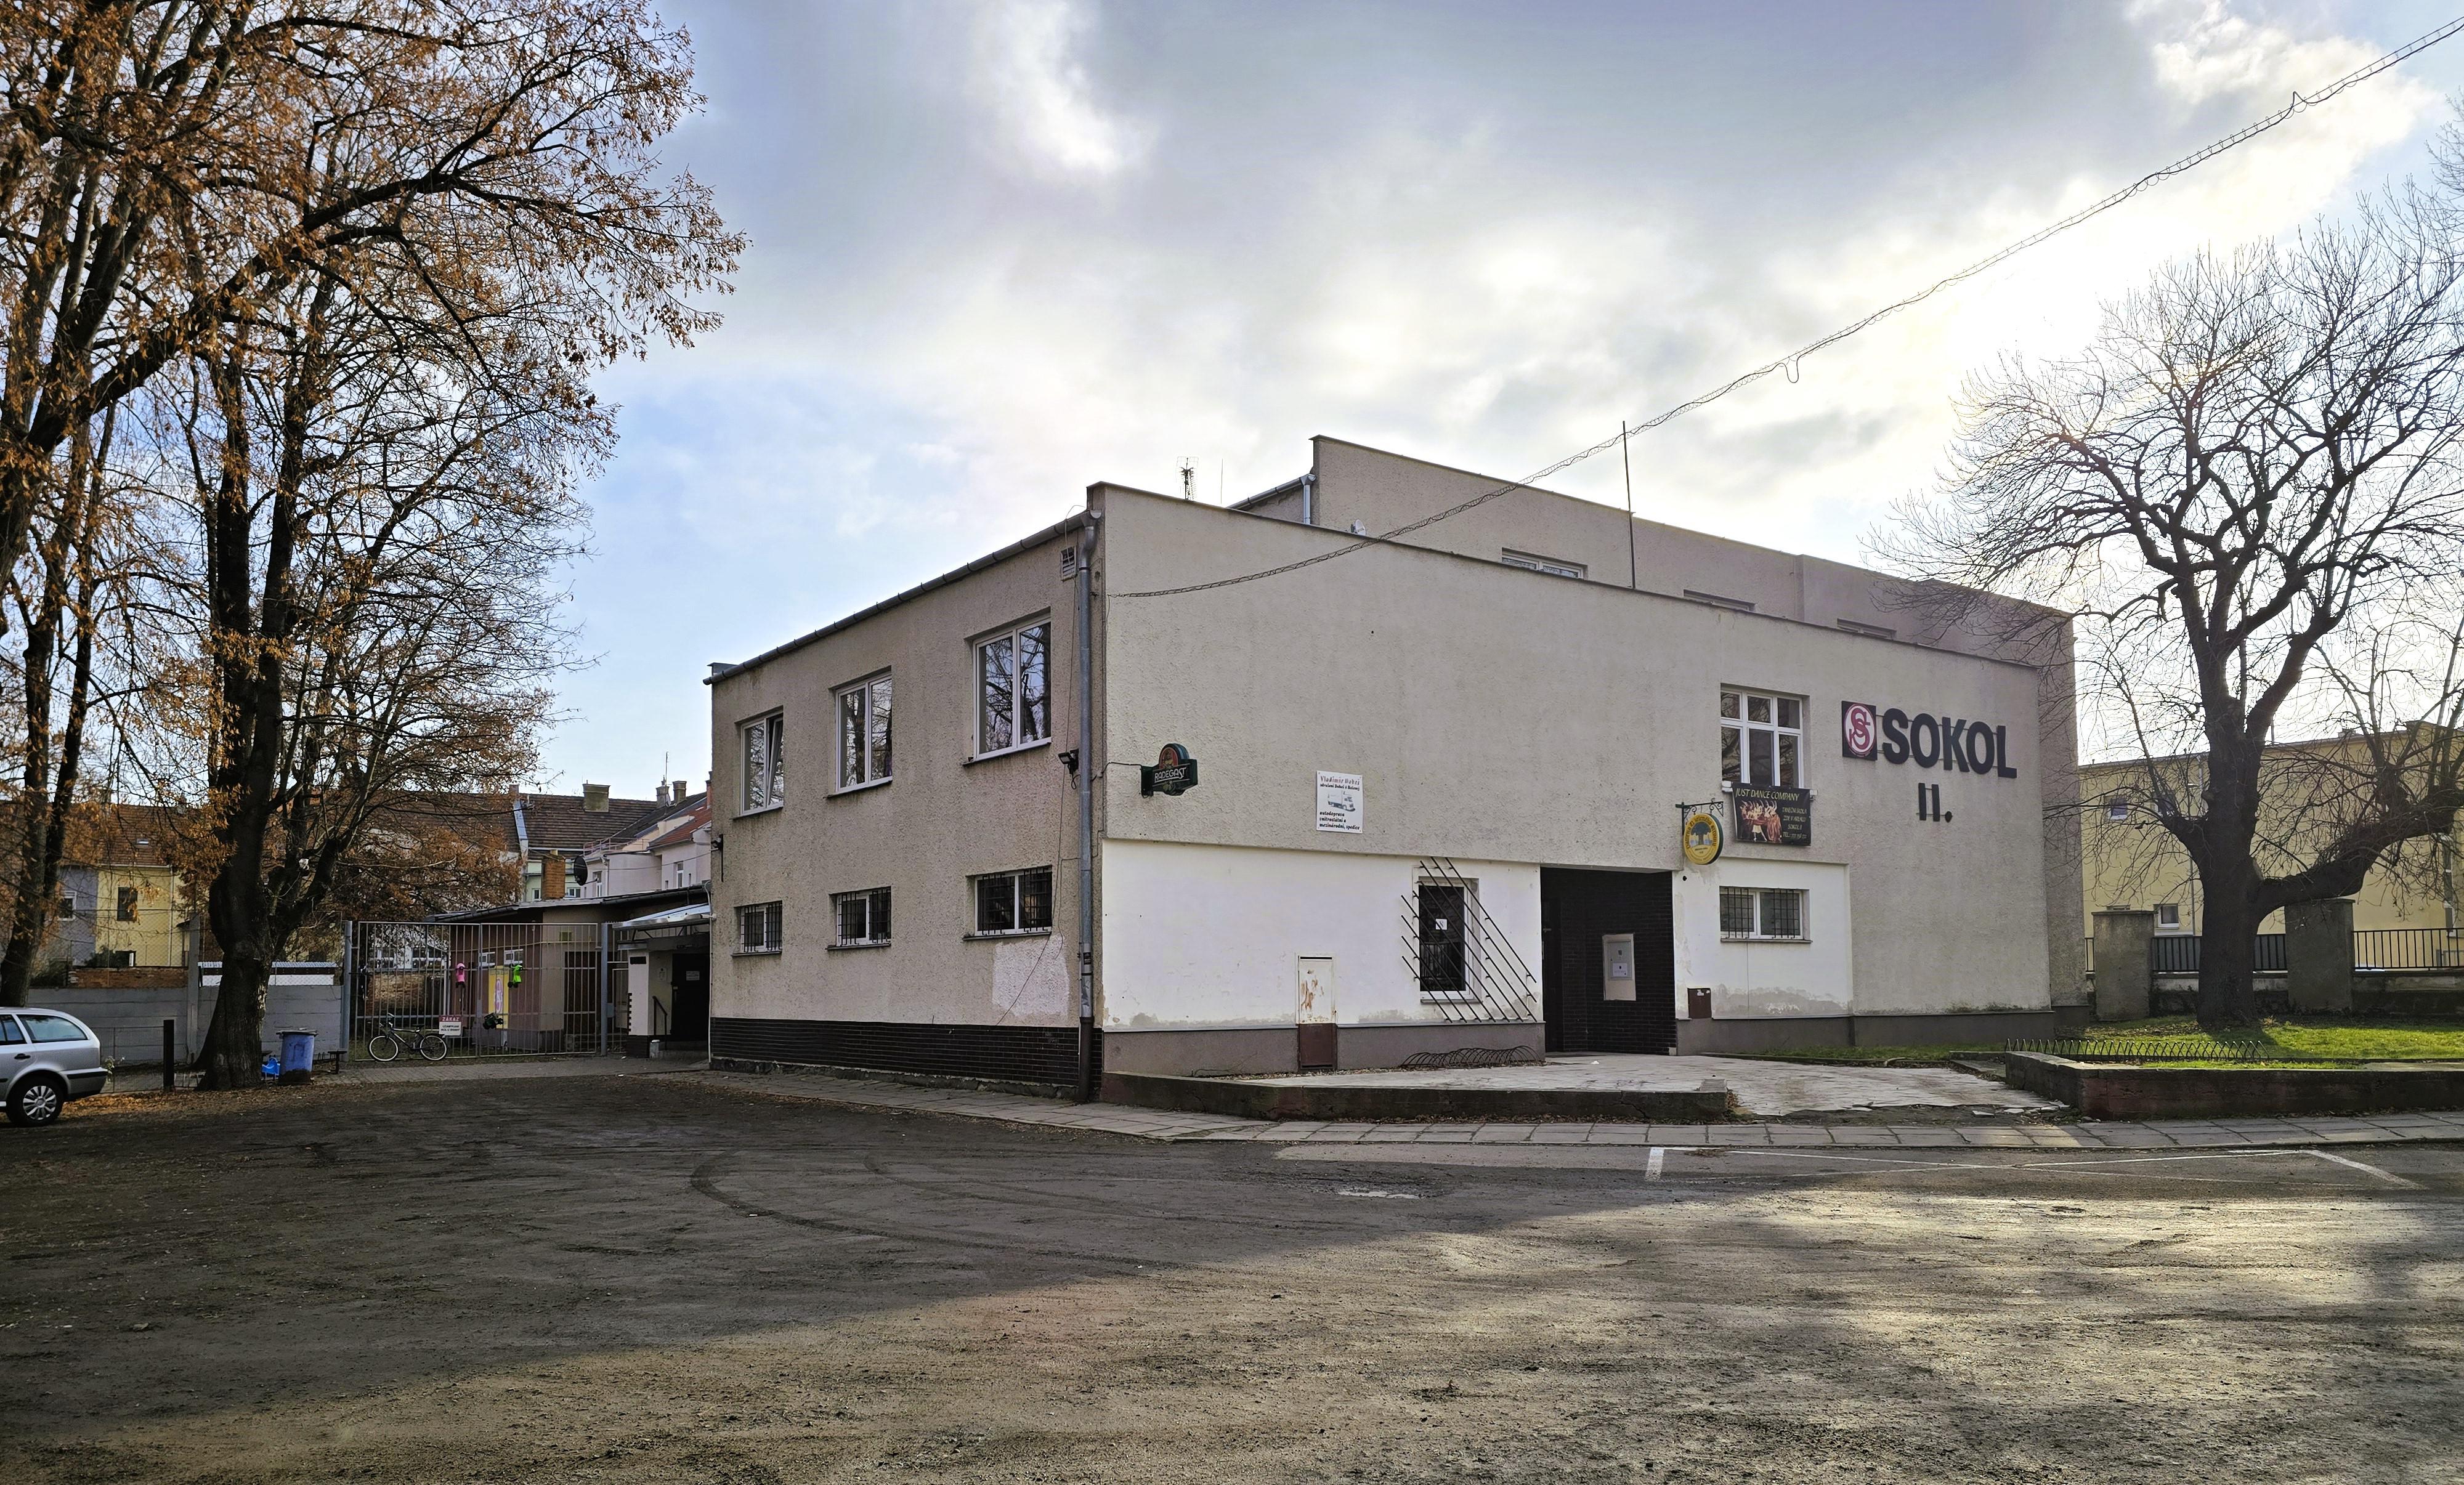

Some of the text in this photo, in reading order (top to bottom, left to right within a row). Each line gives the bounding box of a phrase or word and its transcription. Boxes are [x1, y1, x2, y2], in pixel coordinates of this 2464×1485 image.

[1882, 708, 2017, 779] SOKOL
[1154, 767, 1186, 783] RADEGAST
[1735, 788, 1799, 801] JUST DANCE COMPANY
[1918, 782, 1953, 823] II.
